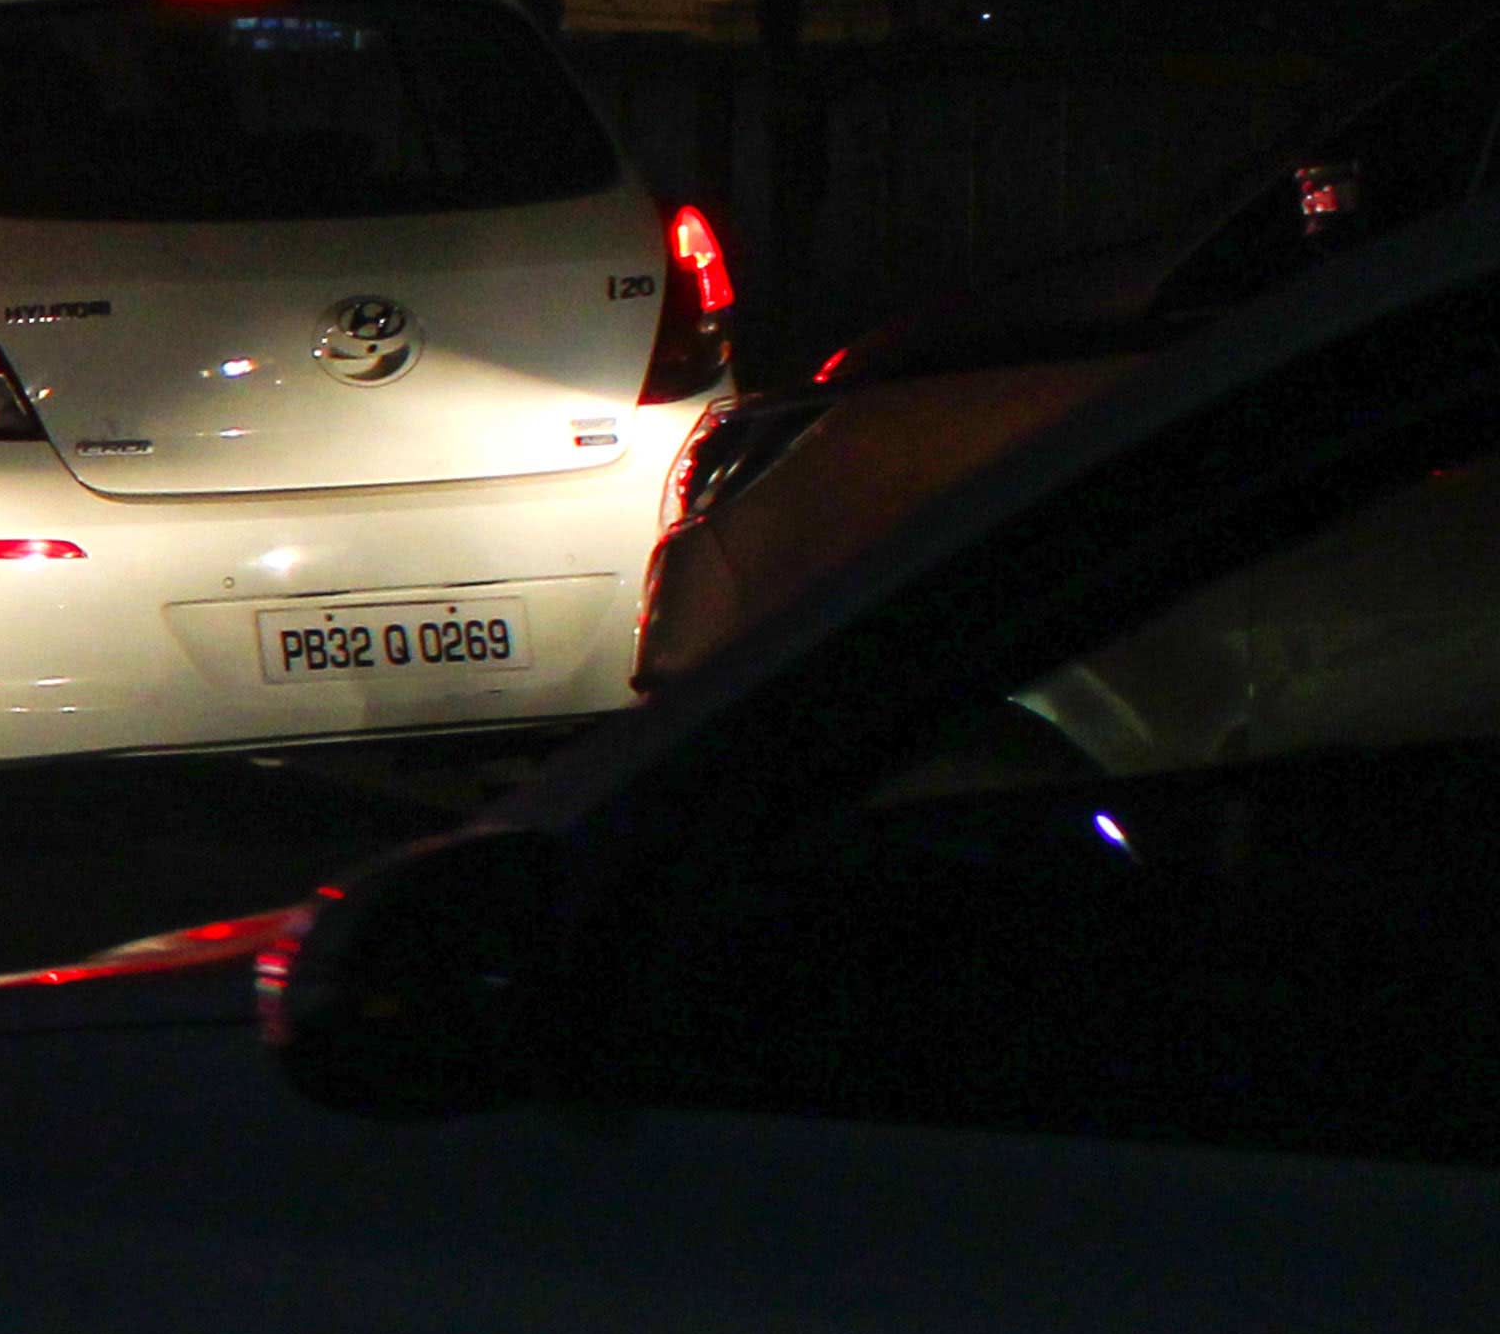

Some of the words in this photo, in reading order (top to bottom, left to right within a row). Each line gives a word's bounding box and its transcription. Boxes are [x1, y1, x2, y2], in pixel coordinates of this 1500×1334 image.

[280, 626, 375, 672] PB32
[383, 624, 411, 666] Q
[418, 619, 512, 663] 0269
